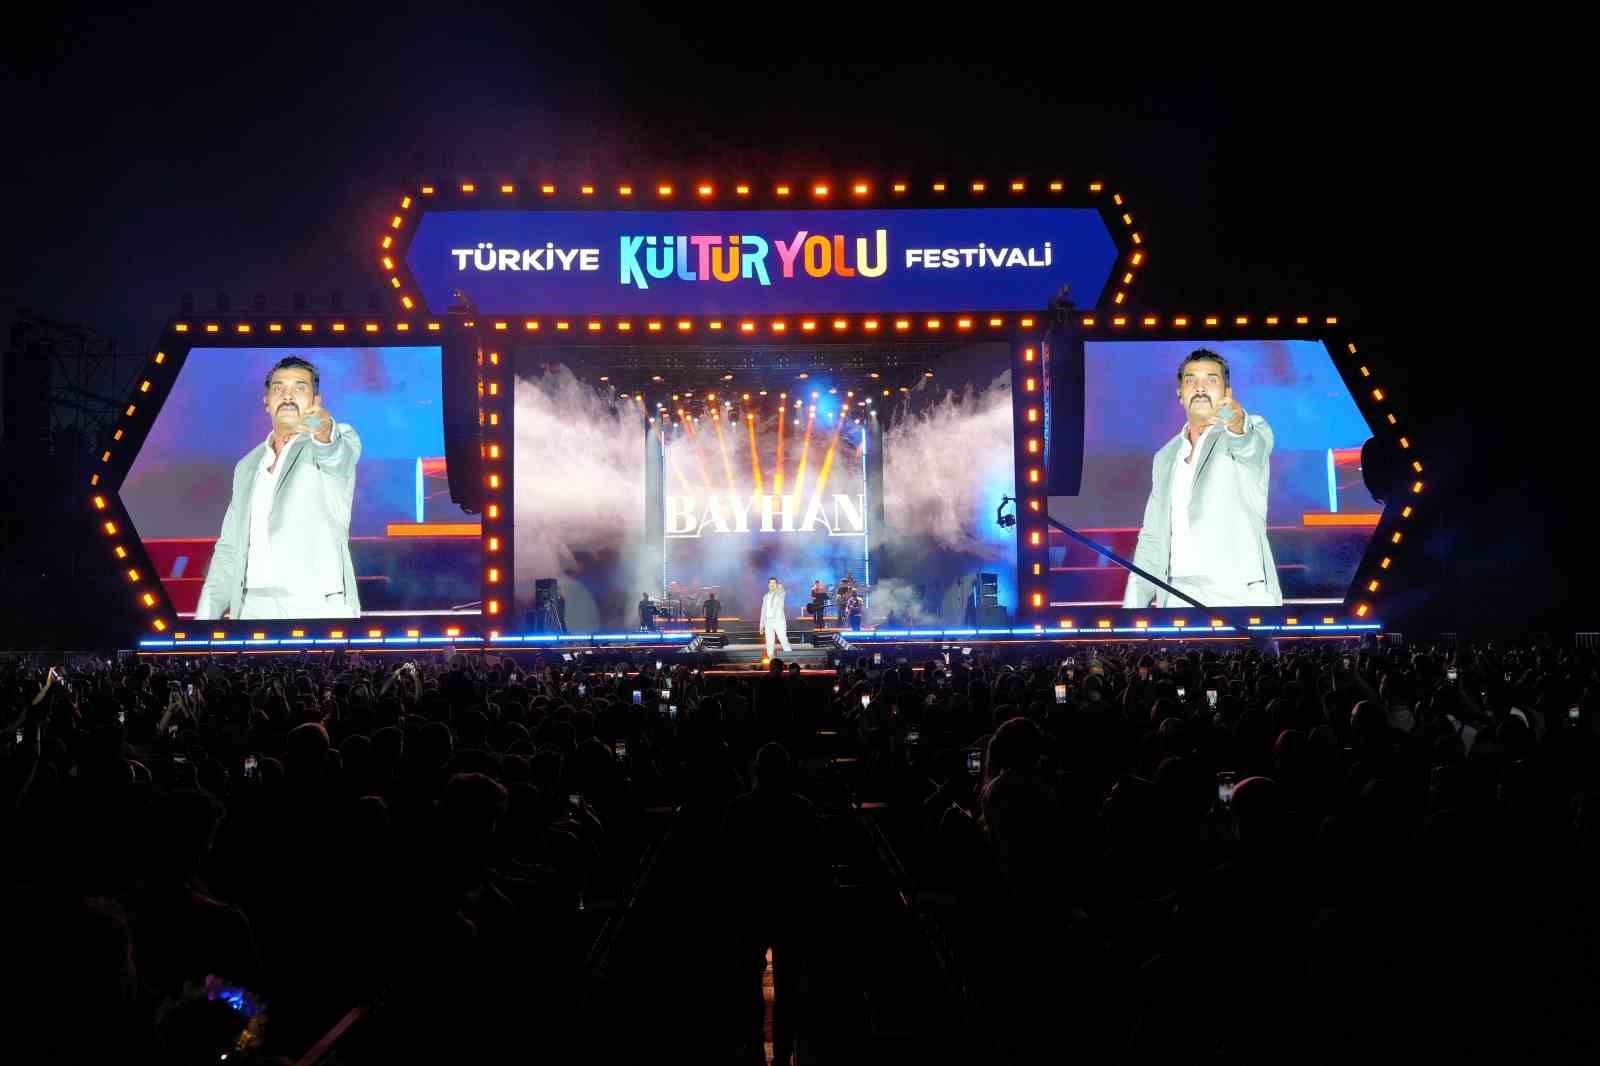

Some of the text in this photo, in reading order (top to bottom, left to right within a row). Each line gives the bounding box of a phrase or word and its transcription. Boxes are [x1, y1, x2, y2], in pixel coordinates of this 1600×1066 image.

[451, 229, 1052, 289] TÜRKİYE KÜLTÜR YOLU FESTİVALİ
[665, 494, 866, 536] BAYHAN
